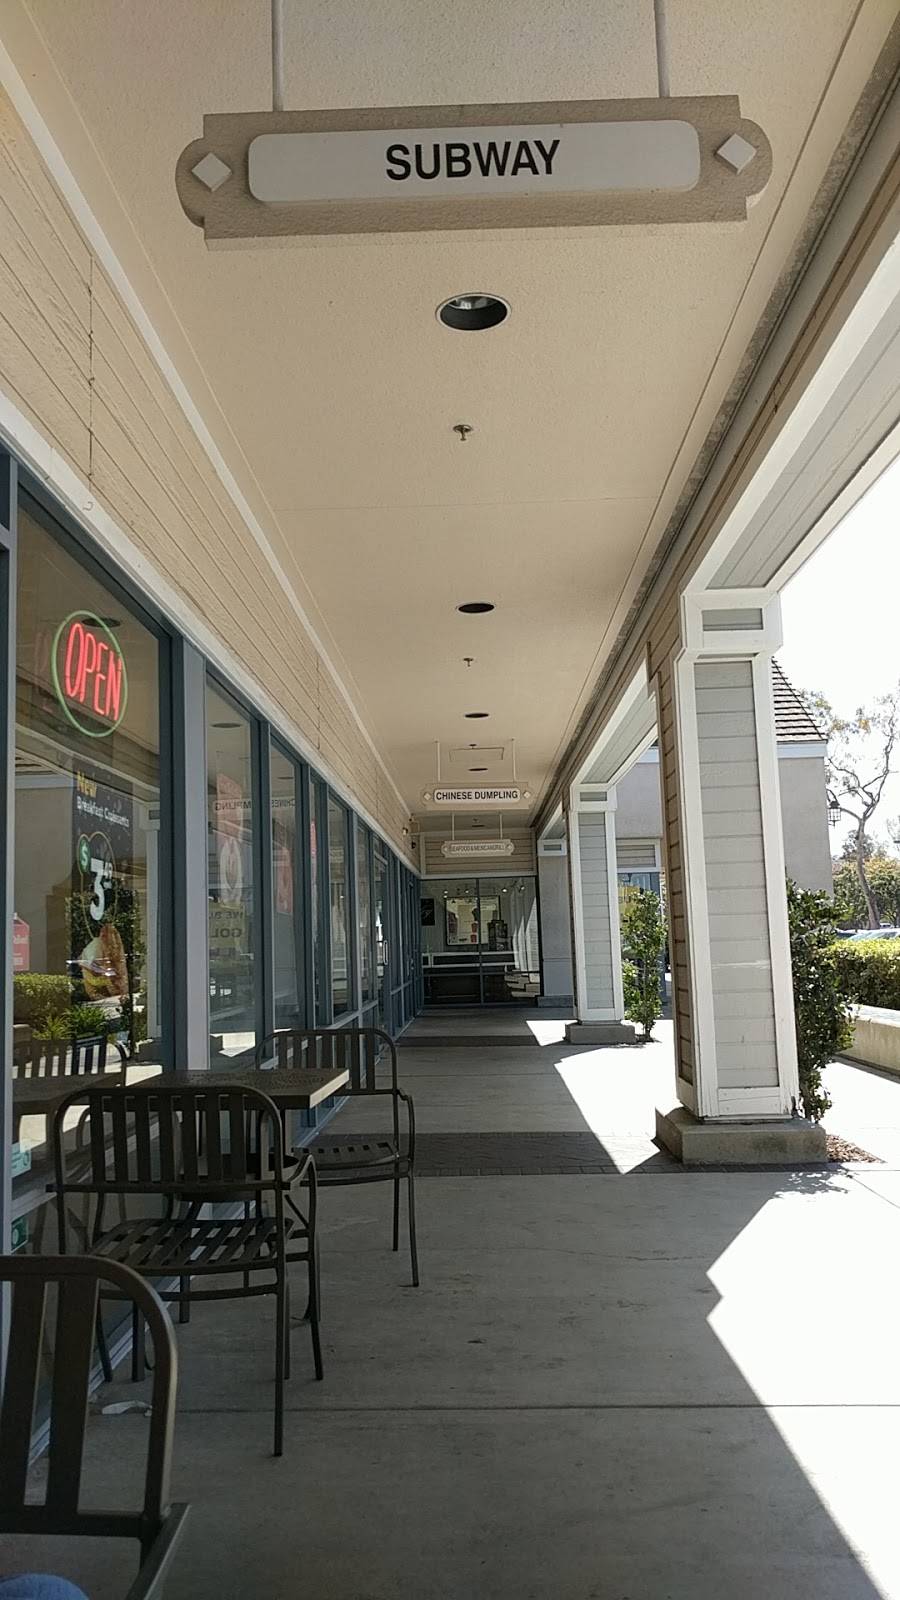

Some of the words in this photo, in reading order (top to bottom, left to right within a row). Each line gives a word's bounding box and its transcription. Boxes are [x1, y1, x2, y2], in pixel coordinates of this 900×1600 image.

[386, 139, 561, 181] SUBWAY
[64, 622, 123, 721] OPEN
[77, 771, 97, 798] New
[436, 791, 472, 800] CHINESE
[474, 790, 518, 800] DUMPLING
[77, 795, 104, 818] Breakfast
